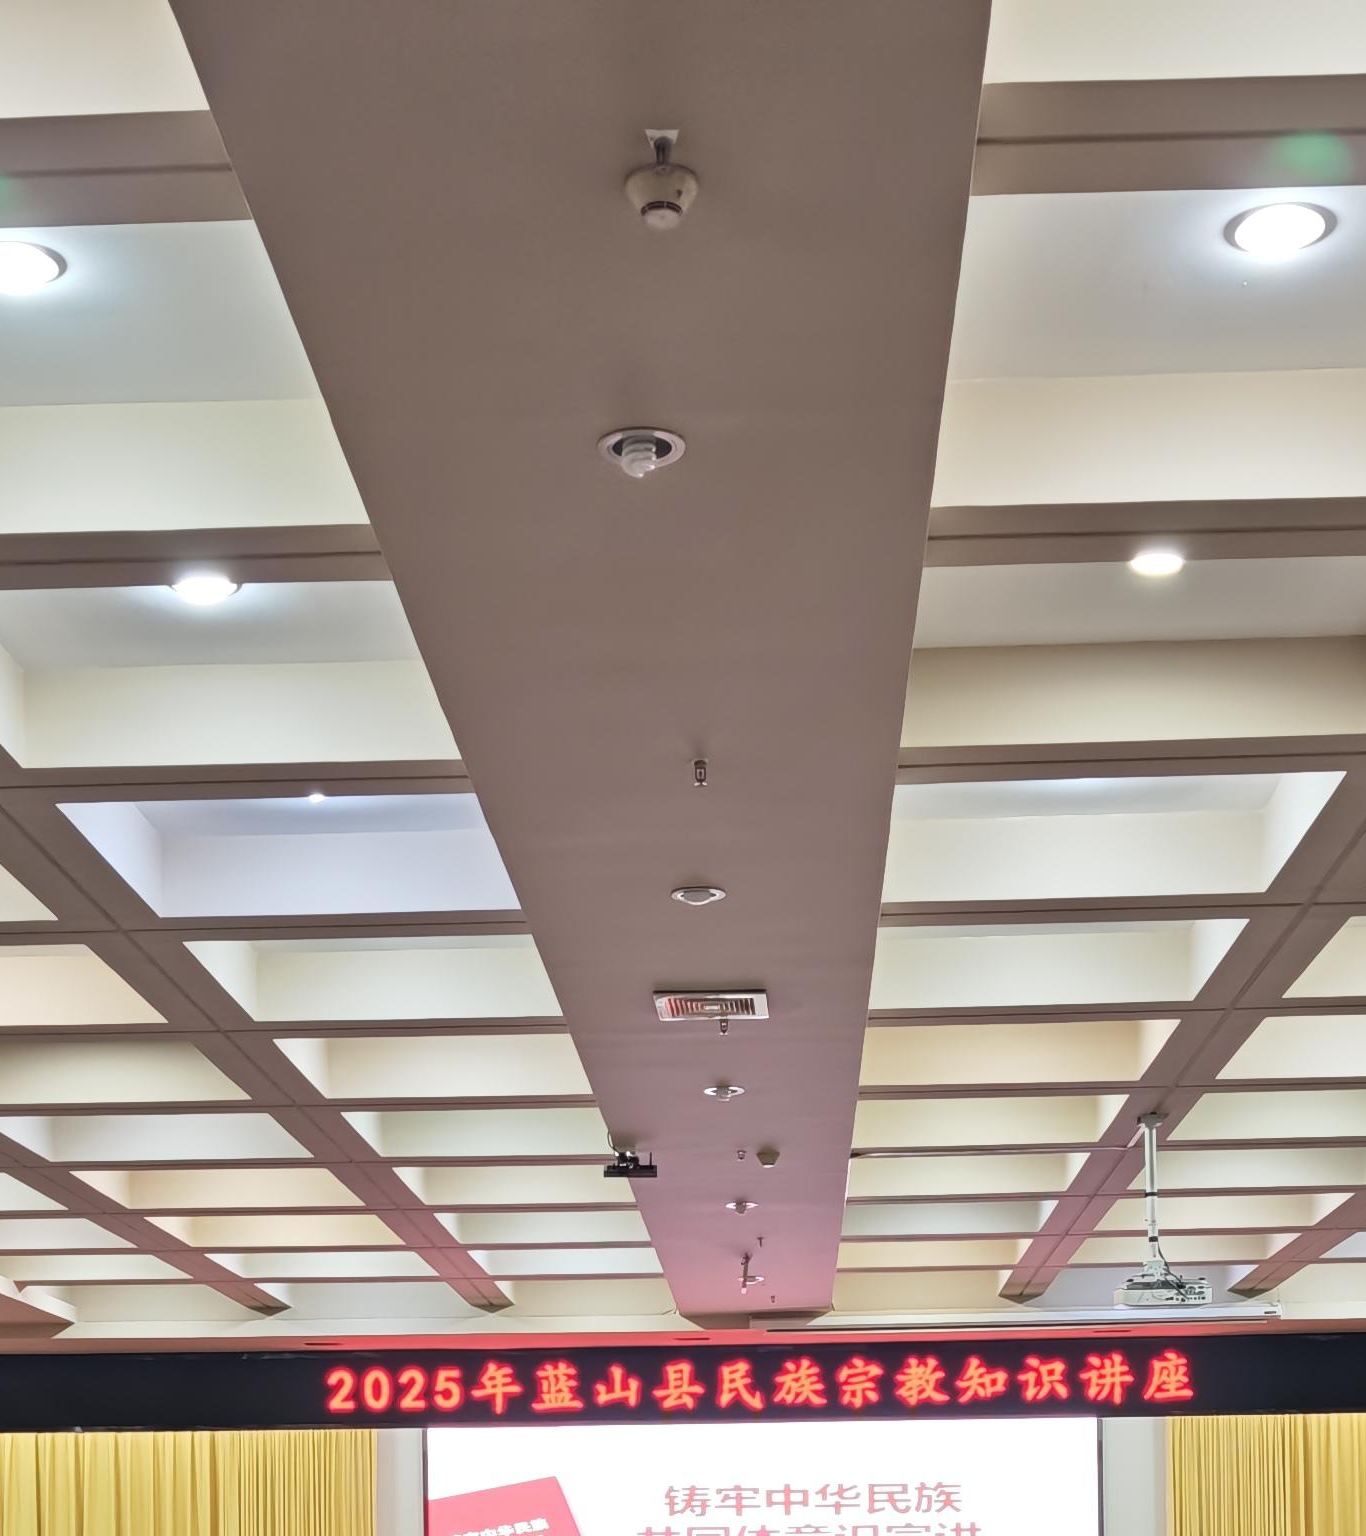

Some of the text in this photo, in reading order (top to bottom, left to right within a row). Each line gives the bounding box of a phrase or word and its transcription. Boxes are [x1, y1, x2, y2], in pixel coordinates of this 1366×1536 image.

[326, 1352, 1194, 1415] 2025年蓝山县民族宗教知识讲座
[664, 1481, 963, 1517] 铸牢中华民族
